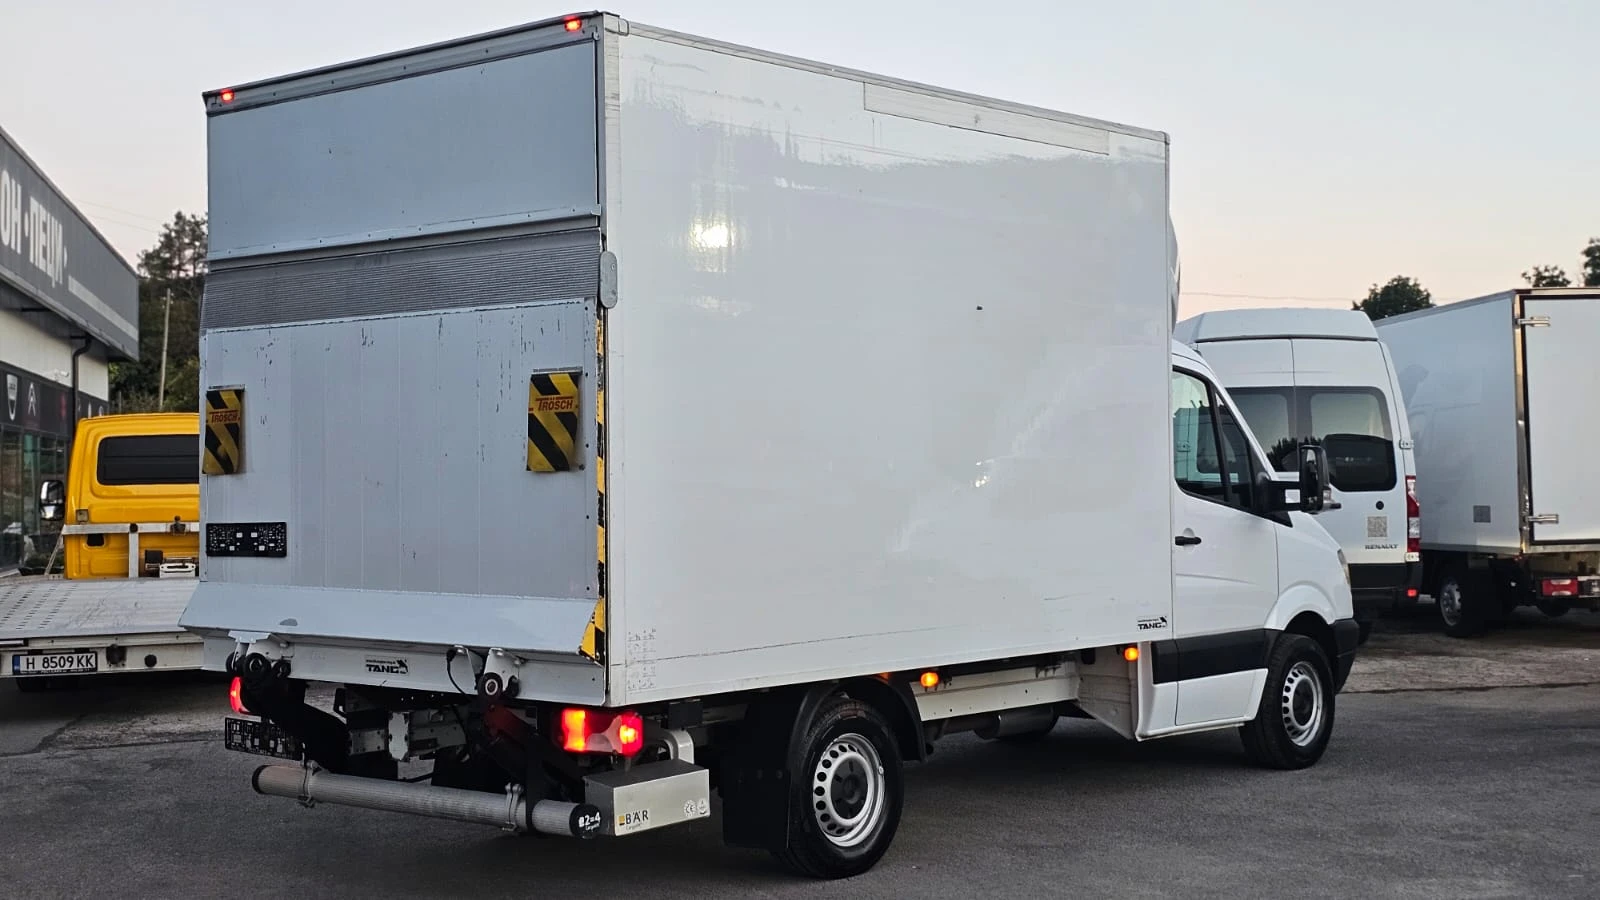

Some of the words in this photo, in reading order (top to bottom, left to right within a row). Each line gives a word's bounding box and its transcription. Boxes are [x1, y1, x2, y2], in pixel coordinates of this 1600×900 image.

[26, 657, 35, 670] H
[42, 656, 74, 669] 8509
[77, 655, 94, 668] KK
[625, 809, 649, 825] BÄR
